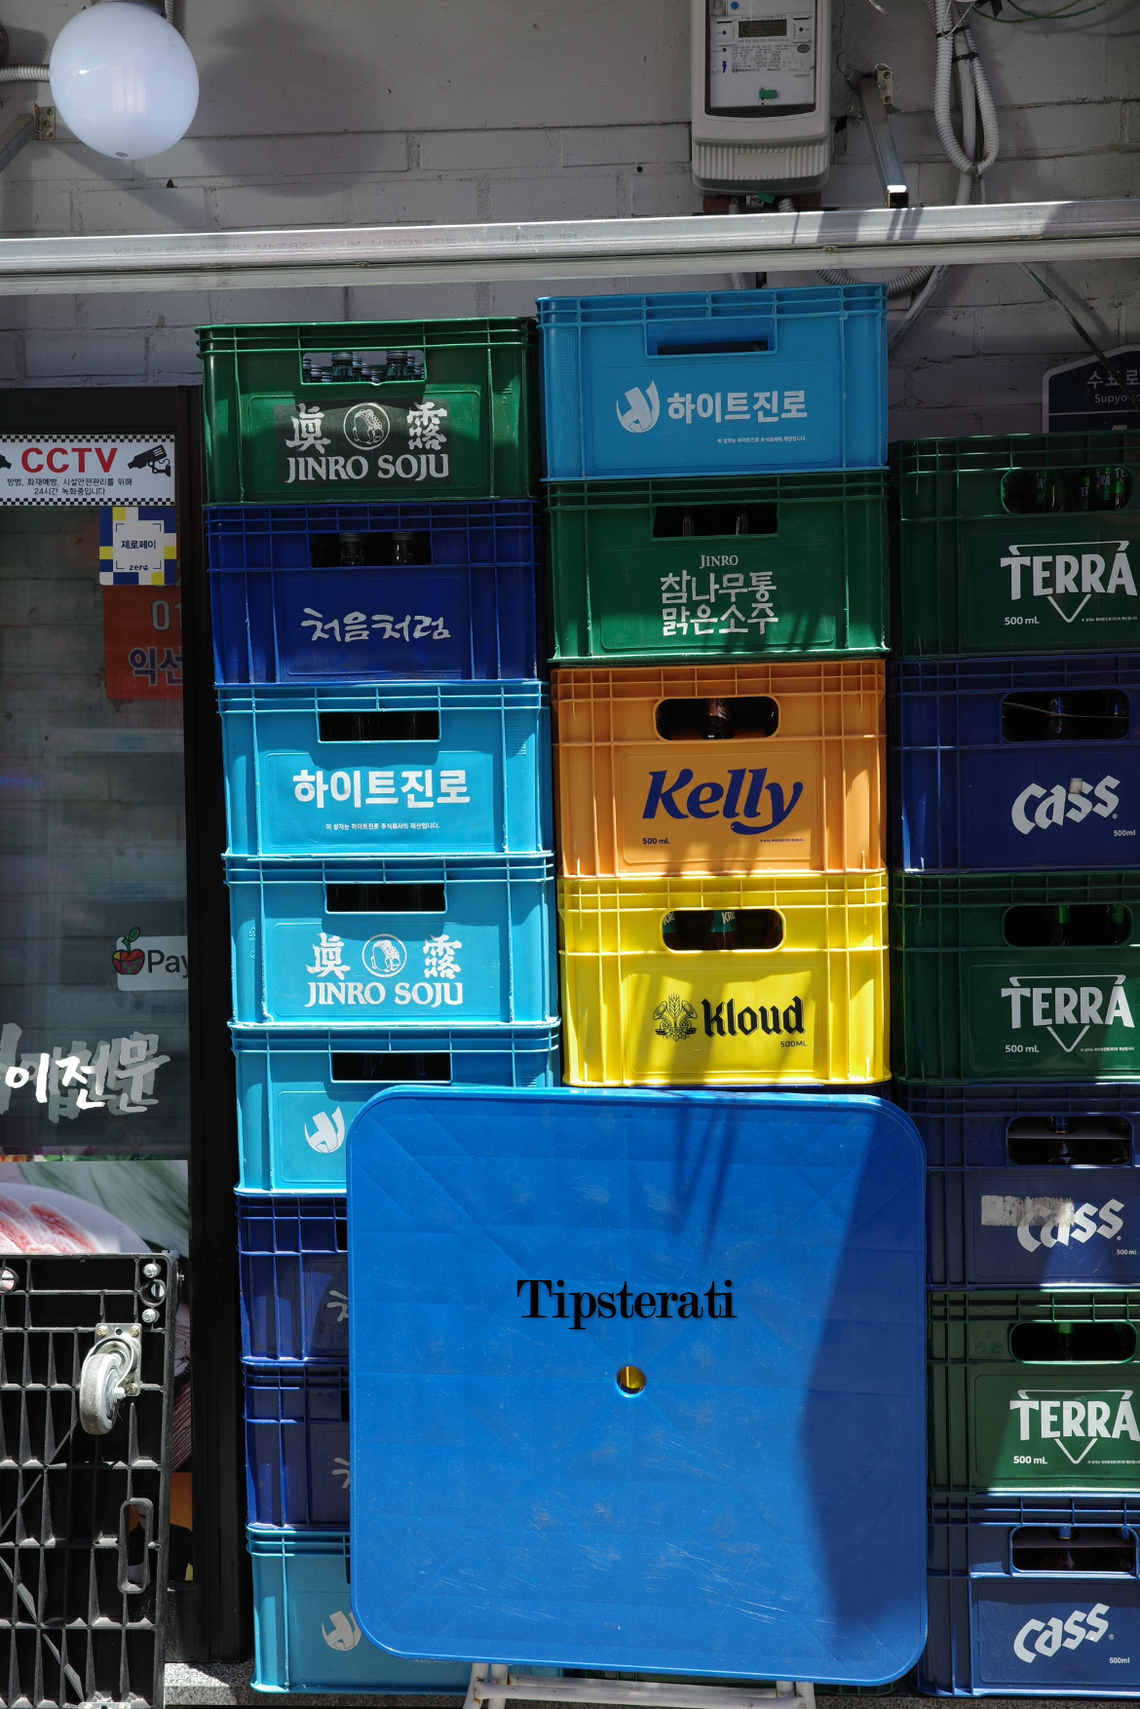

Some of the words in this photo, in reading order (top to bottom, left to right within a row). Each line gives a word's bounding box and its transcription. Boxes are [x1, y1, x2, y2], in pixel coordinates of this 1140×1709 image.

[666, 390, 808, 424] 하이트진로
[21, 447, 118, 474] CCTV
[284, 455, 369, 484] JINRO
[377, 453, 449, 482] SOJU
[27, 477, 60, 487] 화재예방,
[63, 477, 115, 487] 시설안전관리를
[117, 477, 133, 487] 위해
[33, 487, 59, 496] 24시간
[61, 487, 106, 496] 녹화중입니다
[120, 540, 156, 550] 제로페이
[699, 554, 739, 569] JINRO
[660, 569, 777, 604] 참나무통
[1000, 552, 1138, 601] TERRA
[300, 607, 451, 642] 처음처럼
[662, 602, 779, 636] 맑은소주
[1004, 616, 1023, 625] 500
[1025, 616, 1039, 625] mL
[292, 769, 471, 809] 하이트진로
[642, 767, 804, 835] Kelly
[642, 837, 657, 845] 500
[303, 981, 386, 1008] JINRO
[394, 981, 464, 1009] SOJU
[1001, 985, 1136, 1030] TERRA
[1005, 1044, 1023, 1053] 500
[1025, 1044, 1039, 1053] mL
[1009, 1400, 1140, 1442] TERRA
[1013, 1455, 1032, 1464] 500
[1033, 1455, 1048, 1464] mL
